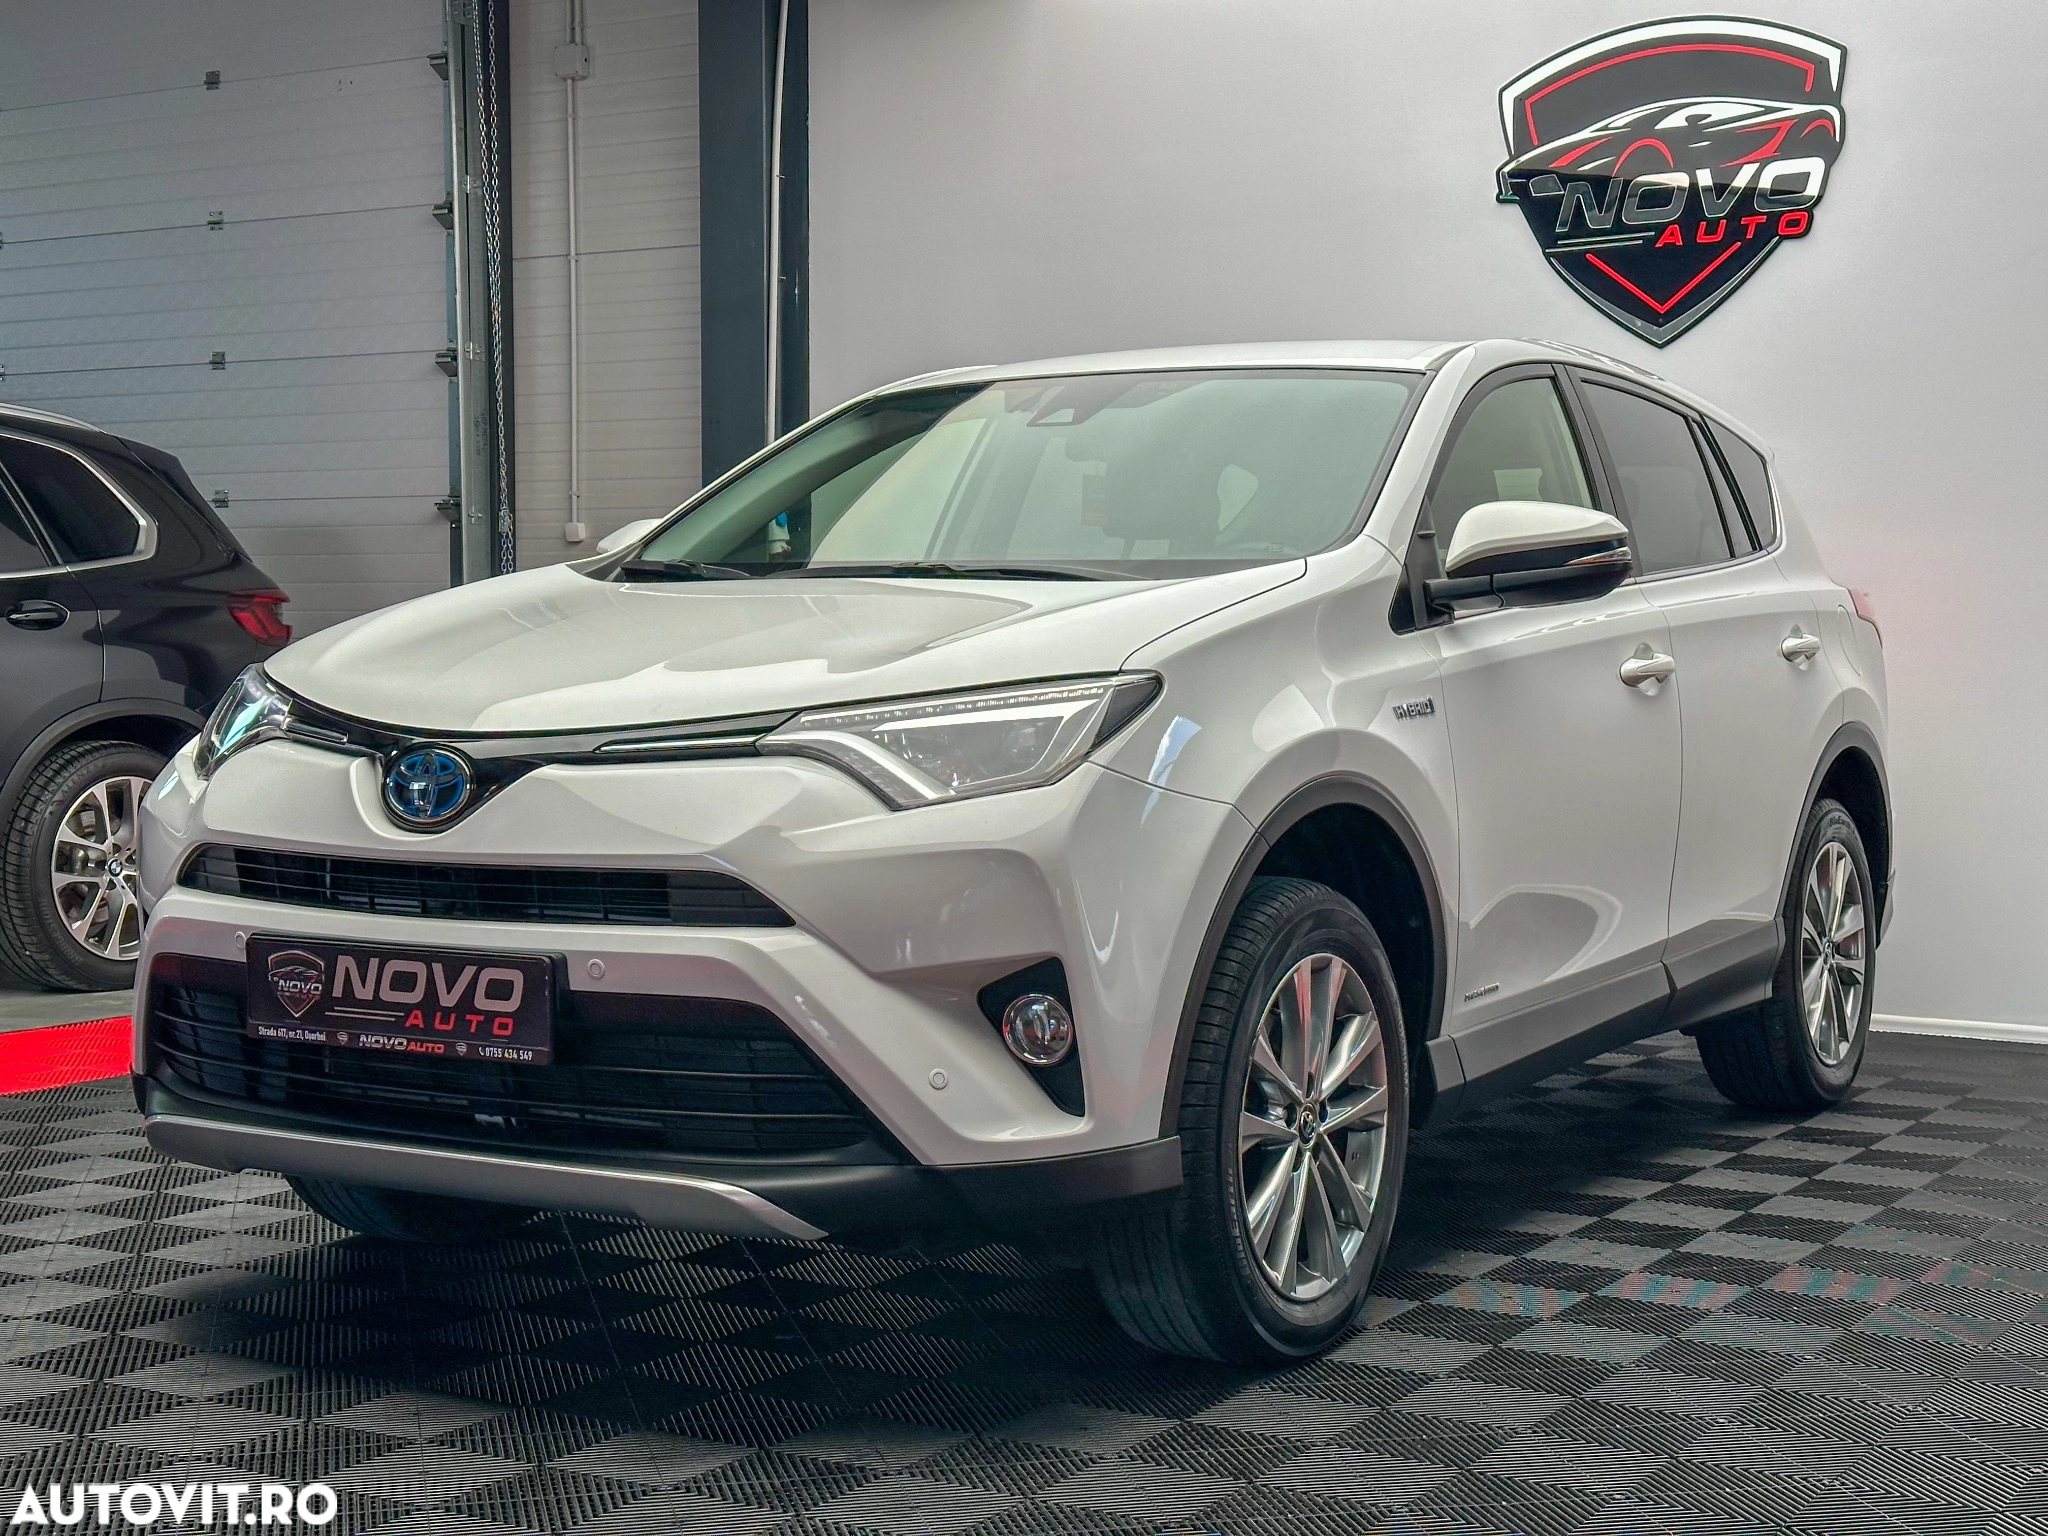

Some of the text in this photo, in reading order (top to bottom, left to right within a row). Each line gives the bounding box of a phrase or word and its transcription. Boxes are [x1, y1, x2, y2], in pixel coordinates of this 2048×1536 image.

[1556, 156, 1826, 232] NOVO
[1655, 211, 1809, 248] AUTO
[1392, 697, 1435, 721] HYBRID
[277, 979, 322, 995] NOVO
[332, 954, 524, 1012] NOVO
[258, 1026, 277, 1037] Strada
[405, 1009, 514, 1036] AUTO
[485, 1047, 533, 1061] 0755 434 549
